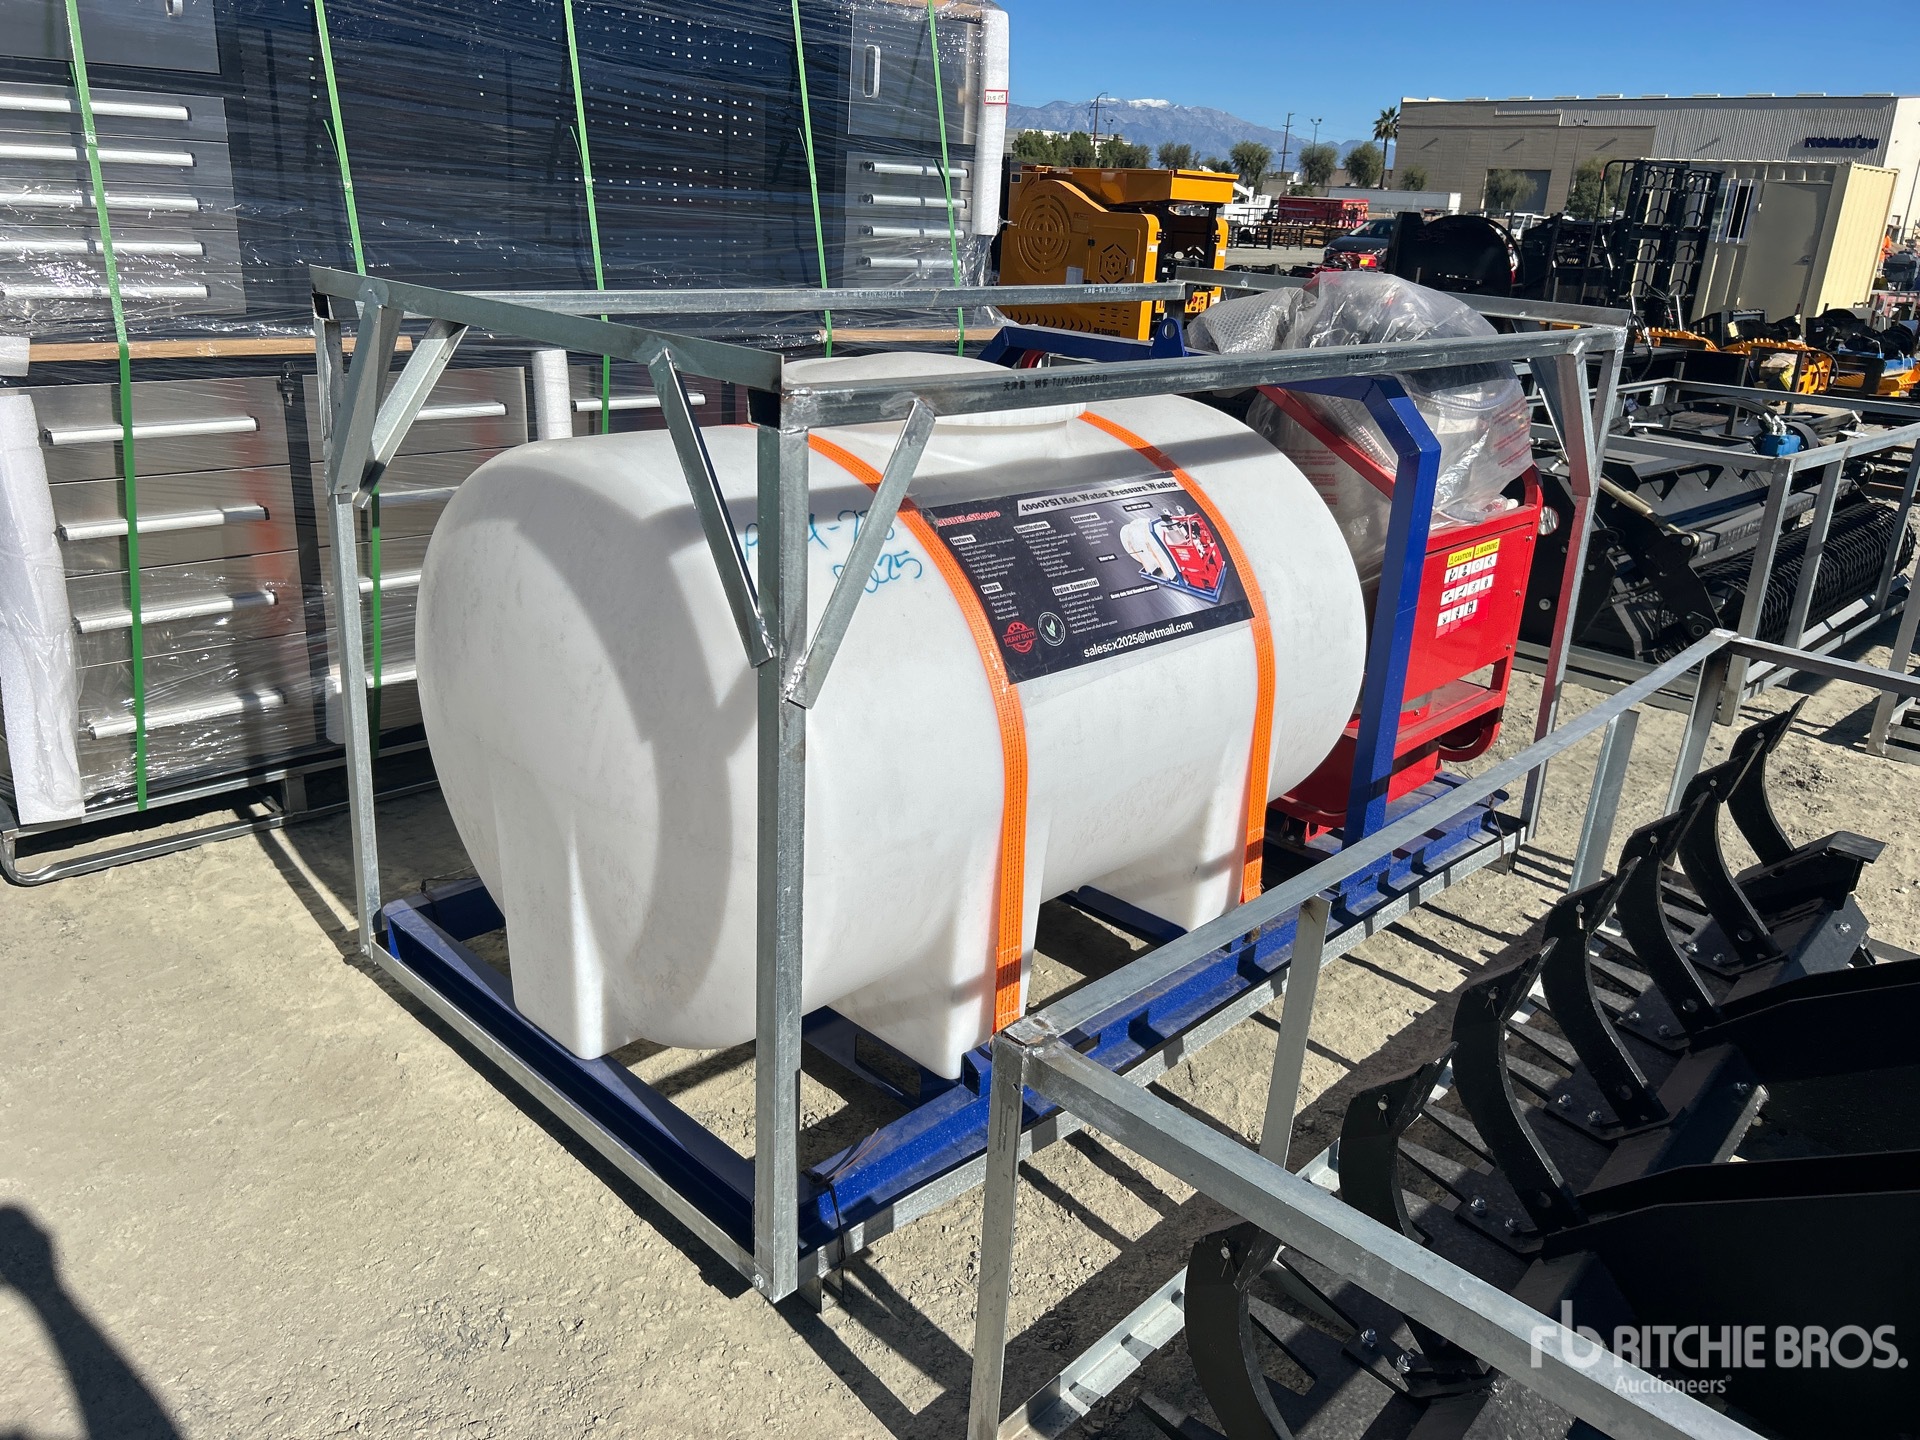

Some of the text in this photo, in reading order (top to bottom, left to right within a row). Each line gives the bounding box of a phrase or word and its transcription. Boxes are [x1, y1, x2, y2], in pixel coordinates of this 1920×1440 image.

[1804, 134, 1879, 149] KOMATSU
[1021, 480, 1178, 512] 4000PSI Hot Water Pressure Washer
[1480, 541, 1499, 553] WARNING
[1454, 551, 1472, 563] CAUTION
[1021, 631, 1036, 640] DUTY
[1083, 621, 1194, 658] salescx2025@hotmail.com
